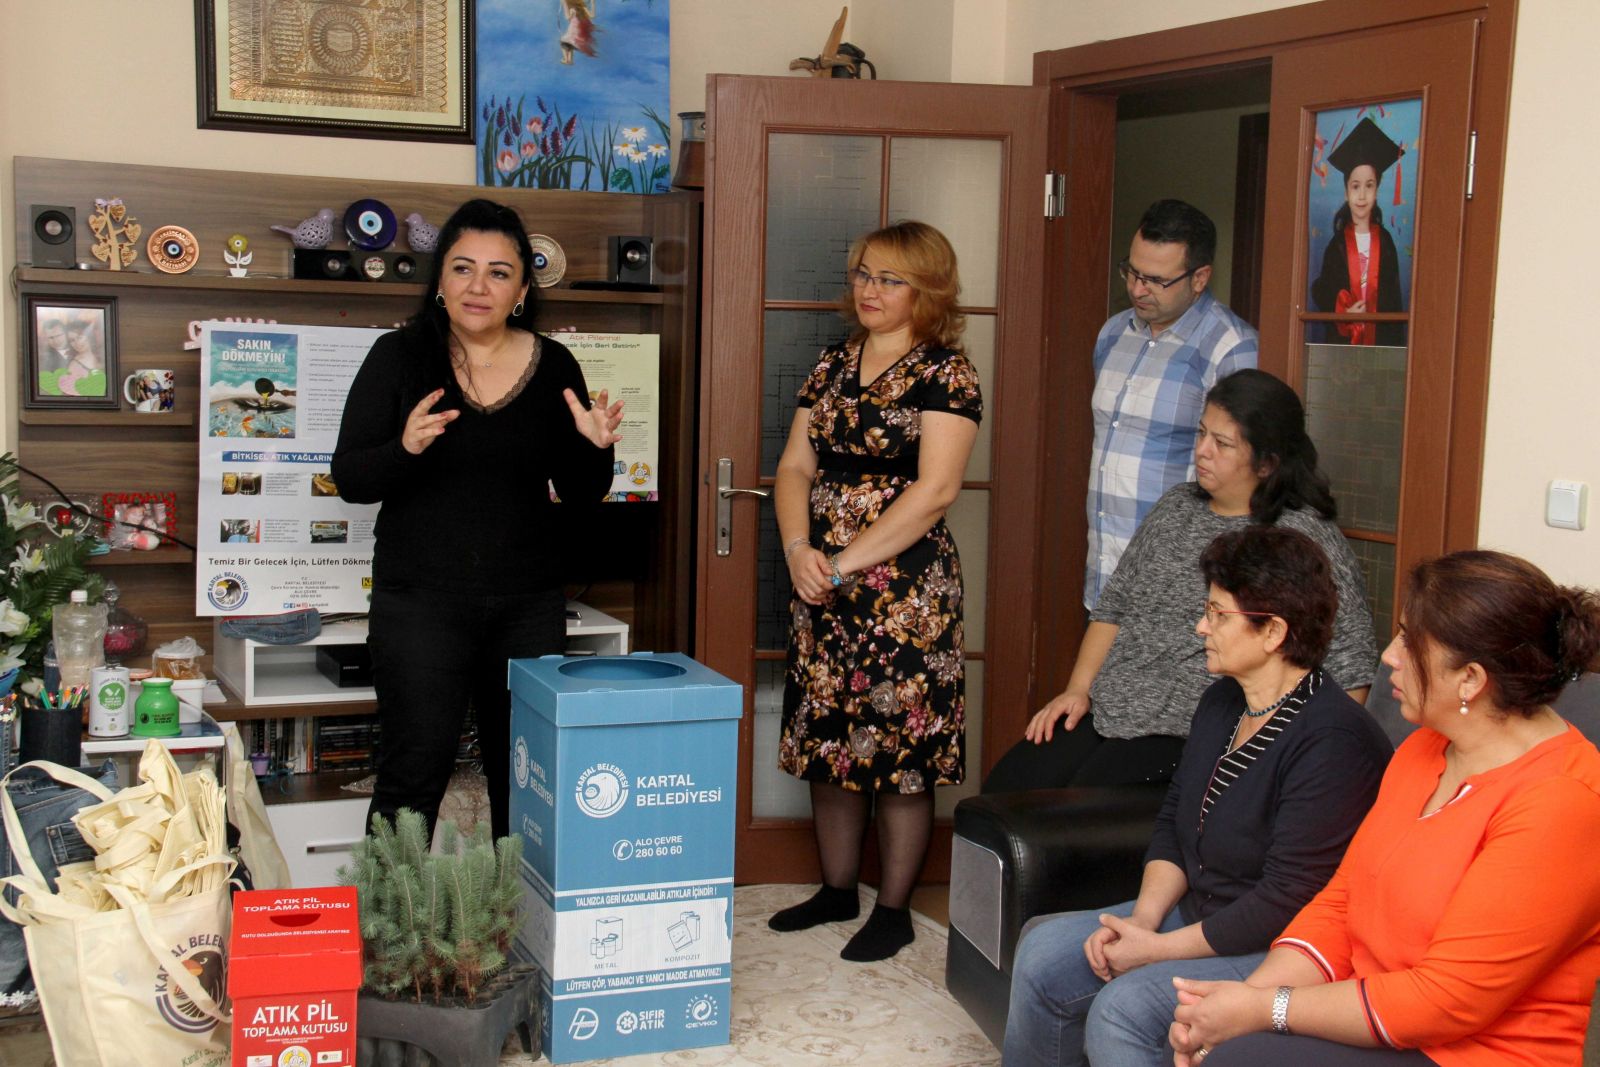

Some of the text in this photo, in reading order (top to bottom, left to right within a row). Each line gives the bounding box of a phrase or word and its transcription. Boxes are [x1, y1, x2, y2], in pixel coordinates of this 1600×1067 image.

[237, 339, 272, 350] SAKIN
[222, 348, 286, 363] DÖKMEYİN!
[232, 452, 269, 461] BİTKİSEL
[271, 453, 290, 461] ATIK
[254, 558, 288, 566] Gelecek
[291, 556, 309, 567] İçin,
[311, 558, 339, 566] Lütfen
[342, 558, 373, 566] Dökme
[208, 573, 223, 591] KARTAL
[530, 759, 546, 783] KARTAL
[576, 763, 630, 791] KARTAL BELEDİYESİ
[637, 774, 695, 788] KARTAL
[530, 776, 554, 807] BELEDİYESİ
[636, 787, 721, 807] BELEDİYESİ
[635, 835, 683, 847] ALO ÇEVRE
[635, 845, 682, 858] 280 60 60
[575, 897, 605, 907] YALNIZCA
[606, 893, 621, 905] GERİ
[621, 889, 667, 903] KAZANILABİLİR
[667, 888, 691, 899] ATIKLAR
[243, 904, 300, 912] TOPLAMA
[594, 962, 618, 970] METAL
[566, 980, 591, 992] LÜTFEN
[592, 977, 607, 991] ÇÖP,
[607, 977, 635, 988] YABANCI
[635, 975, 645, 984] VE
[645, 973, 666, 984] YANICI
[665, 971, 688, 981] MADDE
[252, 1000, 339, 1024] ATIK PİL
[639, 1009, 665, 1021] SIFIR
[242, 1022, 348, 1038] TOPLAMA KUTUSU
[639, 1019, 665, 1031] ATIK
